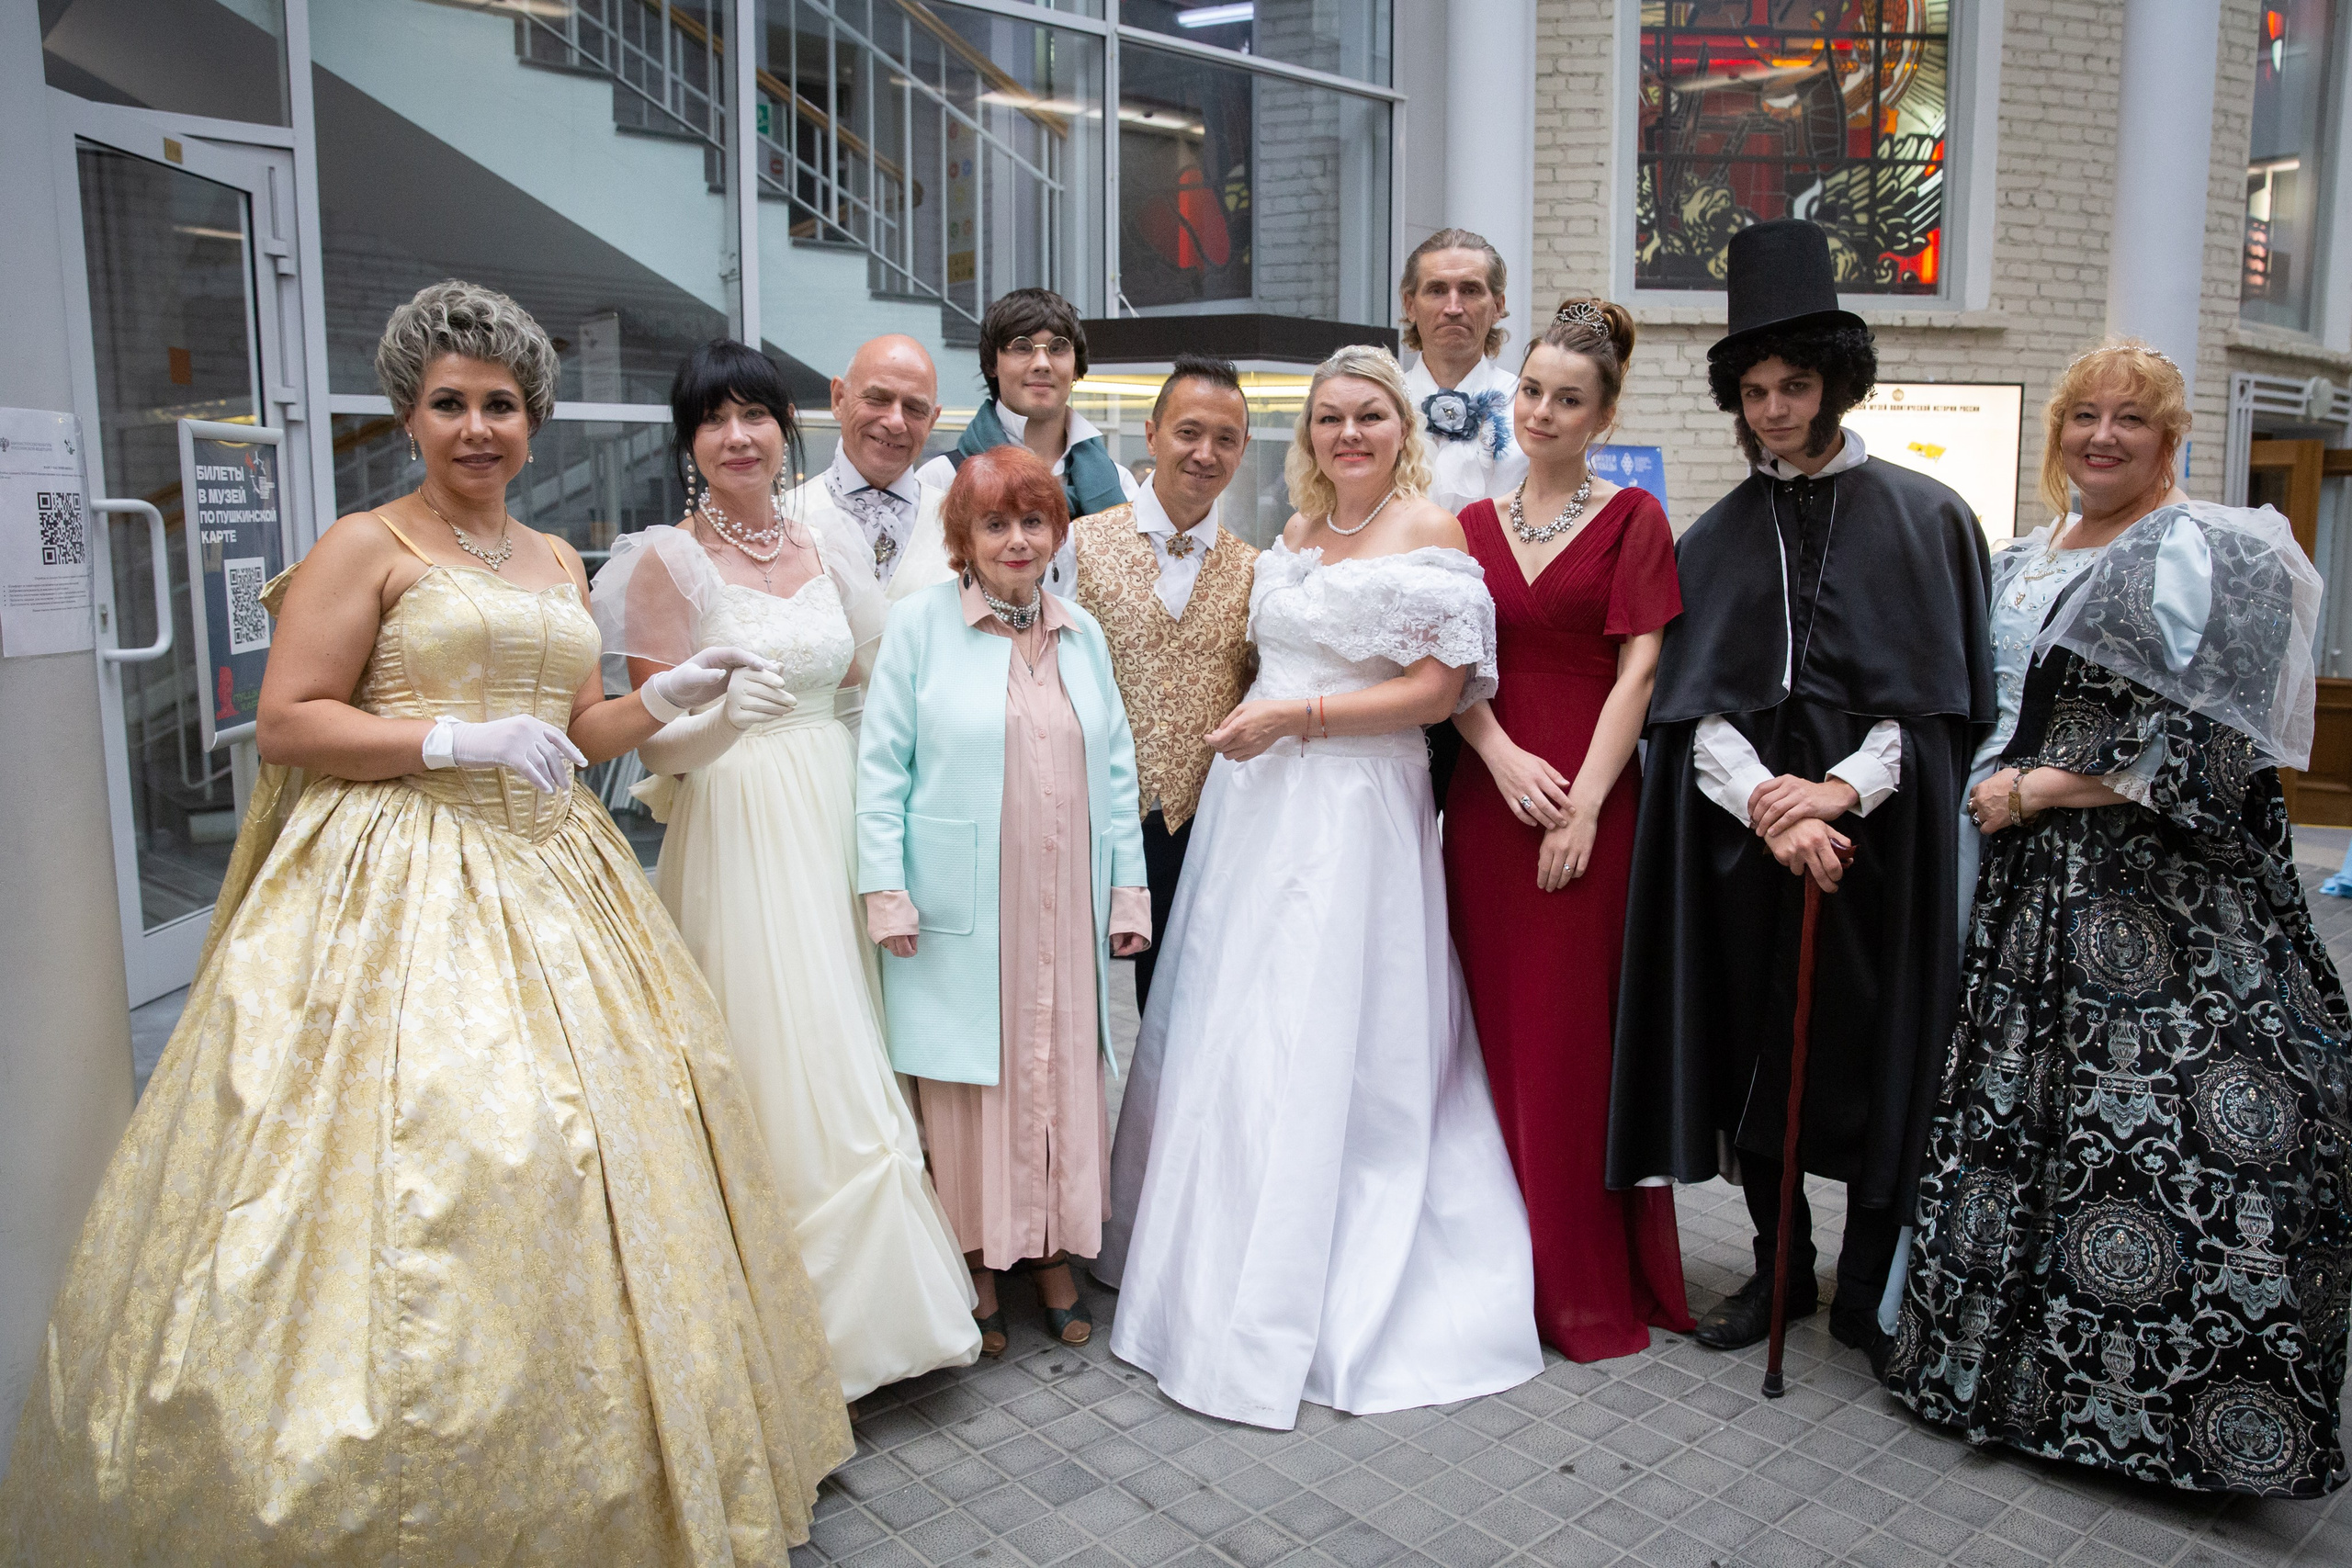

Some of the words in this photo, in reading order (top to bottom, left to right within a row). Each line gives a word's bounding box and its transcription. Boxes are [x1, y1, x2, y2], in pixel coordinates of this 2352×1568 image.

[196, 465, 245, 482] БИЛЕТЫ
[198, 489, 208, 503] В
[208, 486, 247, 504] МУЗЕЙ
[199, 510, 216, 525] ПО
[215, 507, 277, 525] ПУШКИНСКОЙ
[201, 529, 237, 545] КАРТЕ
